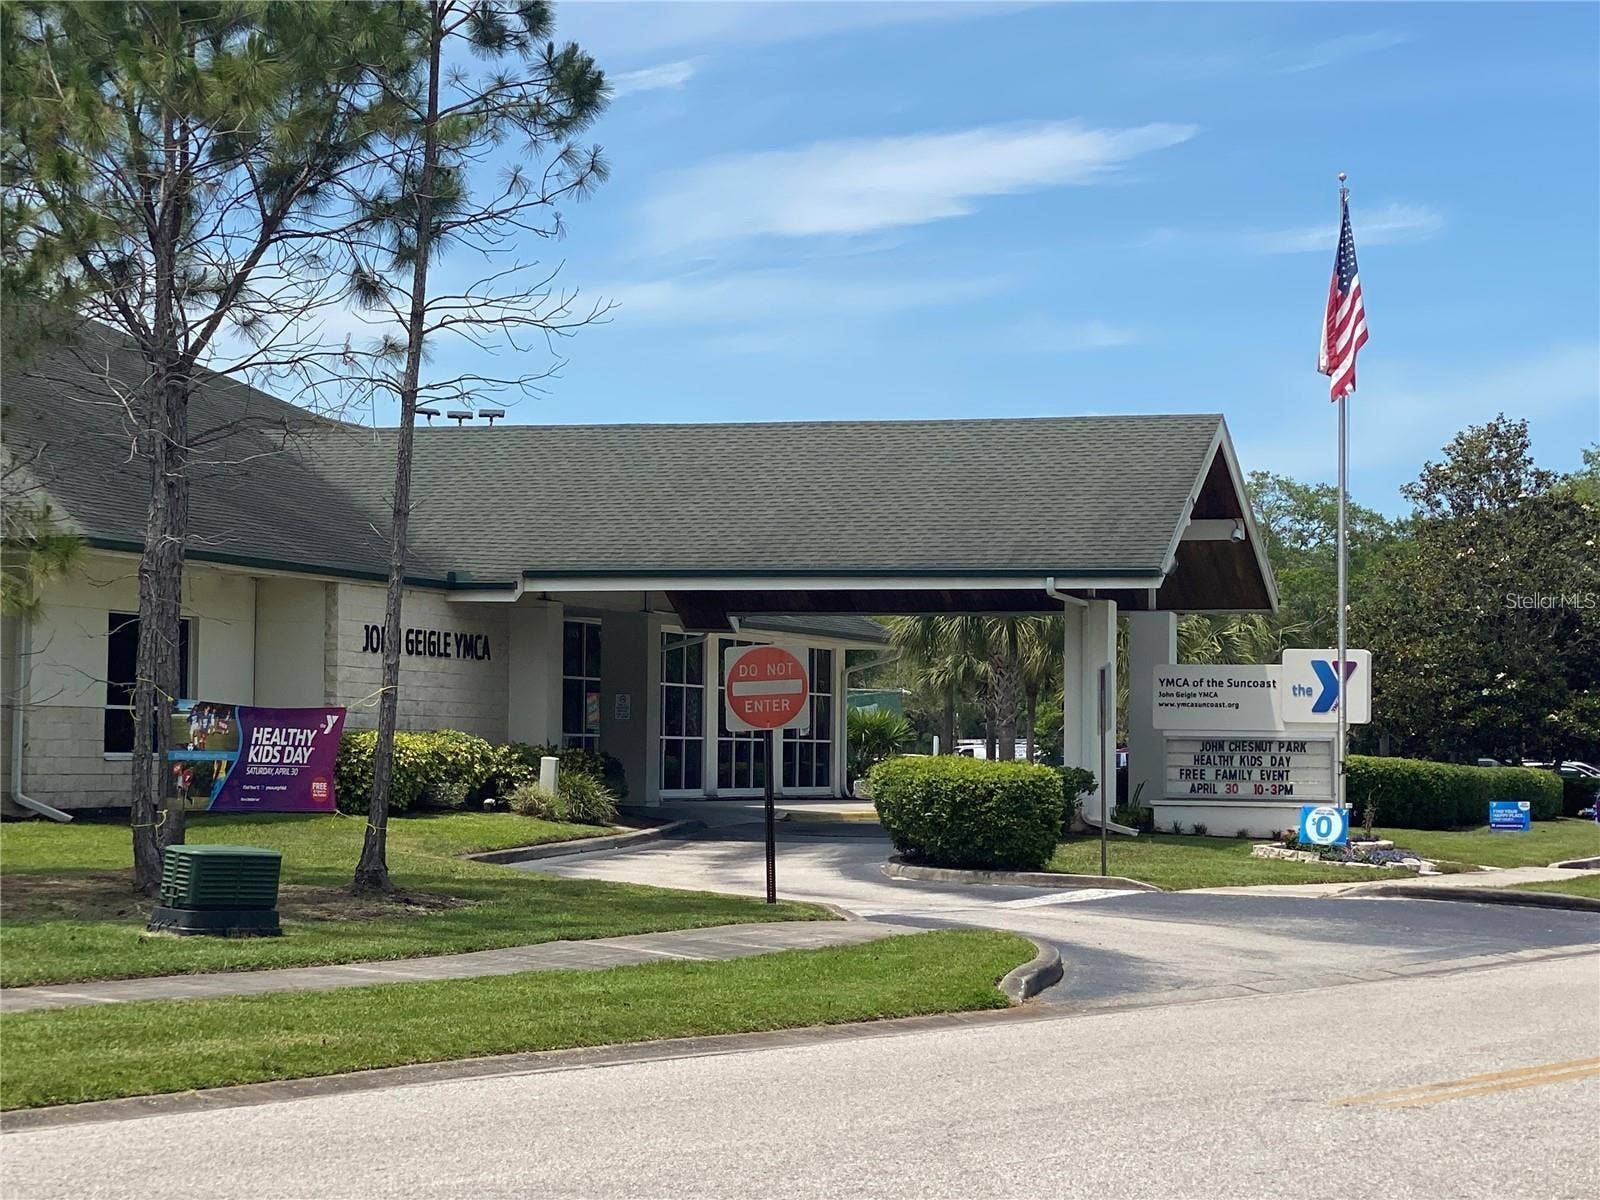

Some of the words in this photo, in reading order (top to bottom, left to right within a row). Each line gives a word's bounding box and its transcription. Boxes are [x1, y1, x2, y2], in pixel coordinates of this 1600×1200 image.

[363, 625, 401, 653] JO
[405, 628, 451, 658] GEIGLE
[454, 632, 491, 660] YMCA
[739, 664, 758, 677] DO
[767, 663, 793, 676] NOT
[1158, 678, 1190, 688] YMCA
[1193, 677, 1204, 688] of
[1206, 677, 1224, 688] the
[1227, 678, 1277, 689] Suncoast
[1176, 691, 1197, 700] Geigle
[1292, 684, 1313, 697] the
[745, 699, 790, 713] ENTER
[1158, 701, 1240, 709] www.ymcasuncoast.org
[251, 727, 317, 746] HEALTHY
[1200, 741, 1224, 752] JOHN
[1228, 741, 1273, 752] CHESNUT
[1278, 742, 1307, 753] PARK
[248, 746, 283, 764] KIDS
[283, 746, 313, 764] DAY
[1193, 755, 1234, 766] HEALTHY
[1239, 756, 1263, 767] KIDS
[1270, 756, 1291, 767] DAY
[246, 767, 274, 777] SATURDAY,
[274, 767, 291, 776] APRIL
[291, 768, 299, 776] 30
[1179, 768, 1206, 780] FREE
[1215, 769, 1253, 781] FAMILY
[1260, 770, 1290, 781] EVENT
[312, 782, 328, 791] FREE
[1189, 783, 1218, 794] APRIL
[1225, 783, 1239, 794] 30
[1254, 784, 1293, 795] 10-3PM
